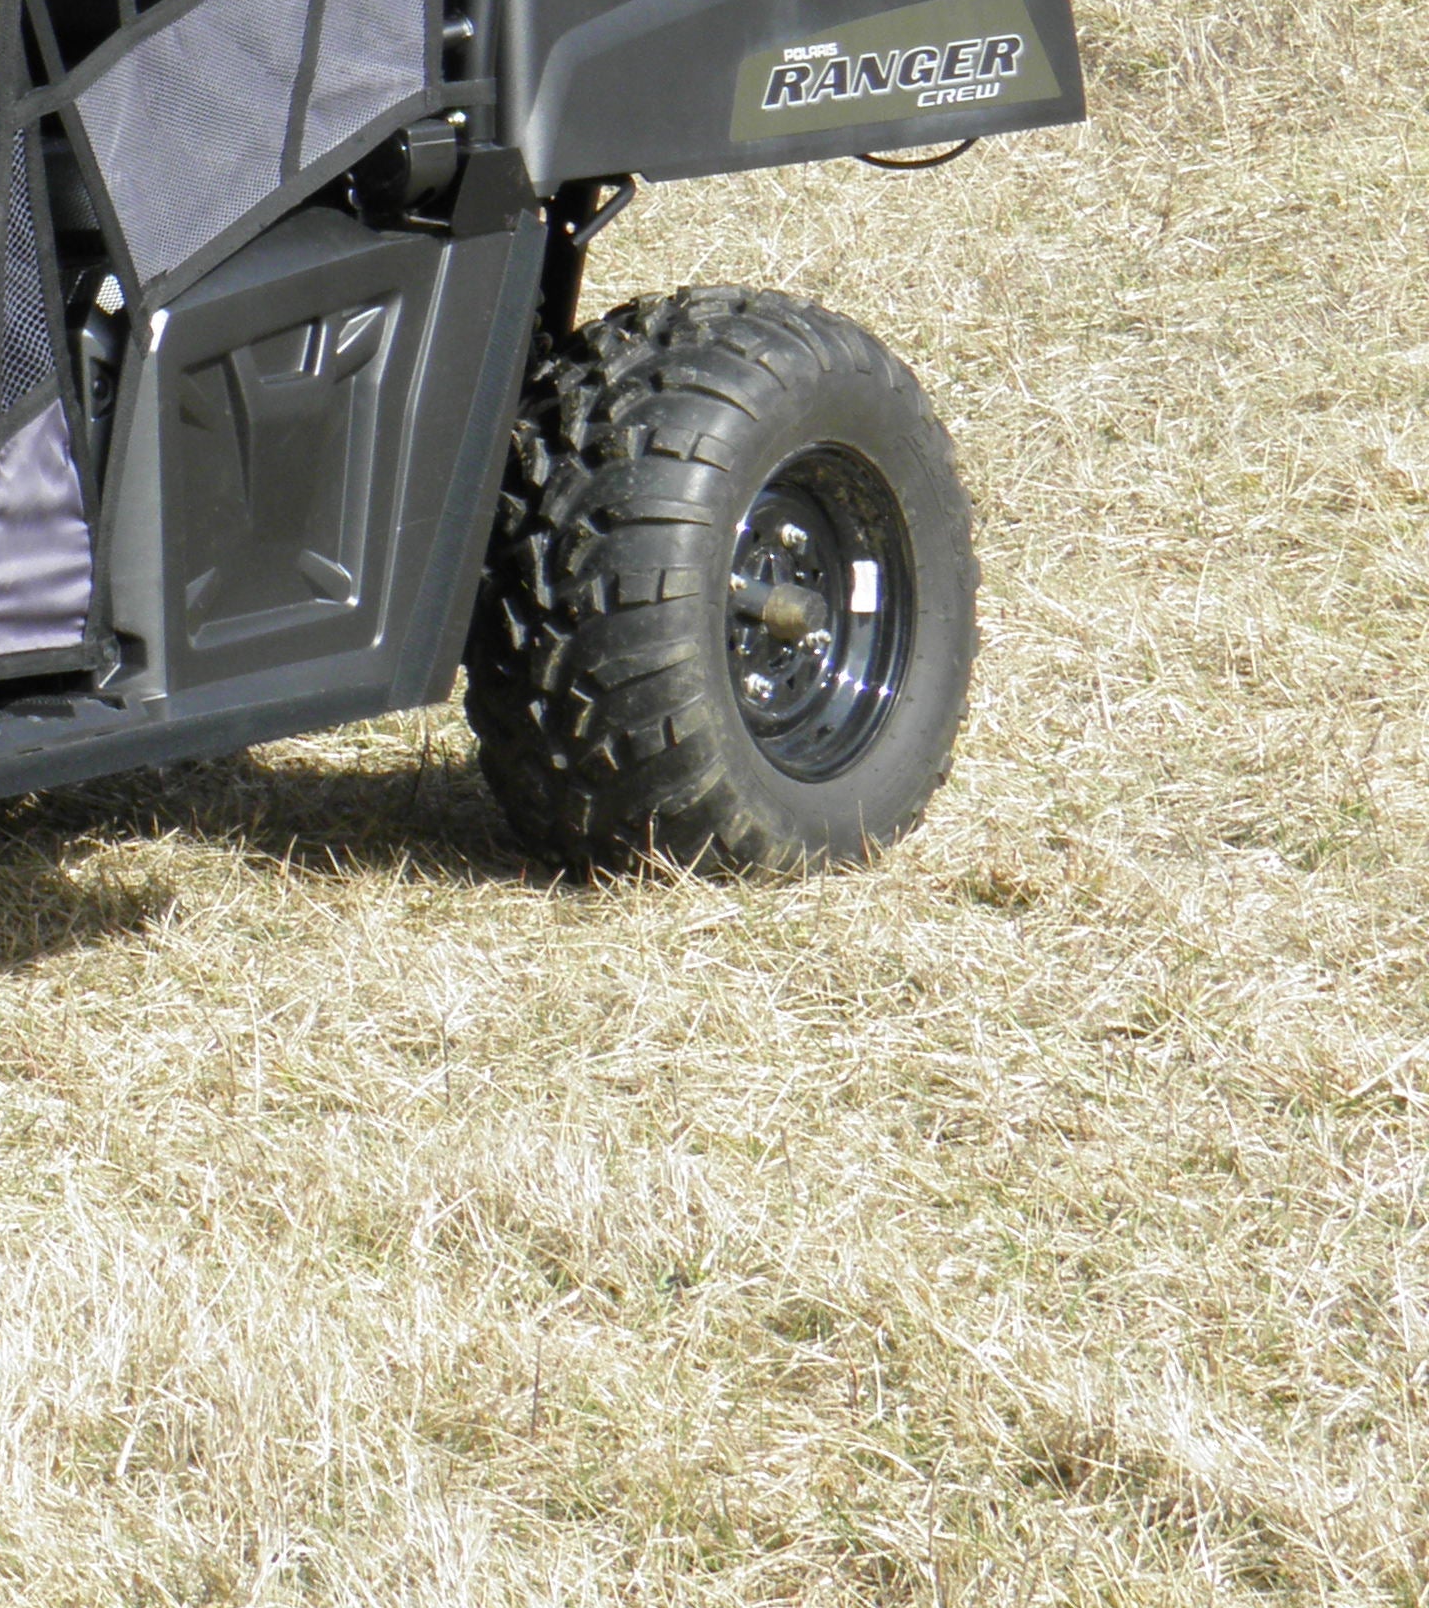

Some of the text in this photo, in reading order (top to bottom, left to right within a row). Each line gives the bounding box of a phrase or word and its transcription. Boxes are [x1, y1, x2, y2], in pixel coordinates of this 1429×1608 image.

[783, 42, 838, 63] POLARIS
[761, 34, 1024, 110] RANGER
[916, 82, 1000, 108] CREW
